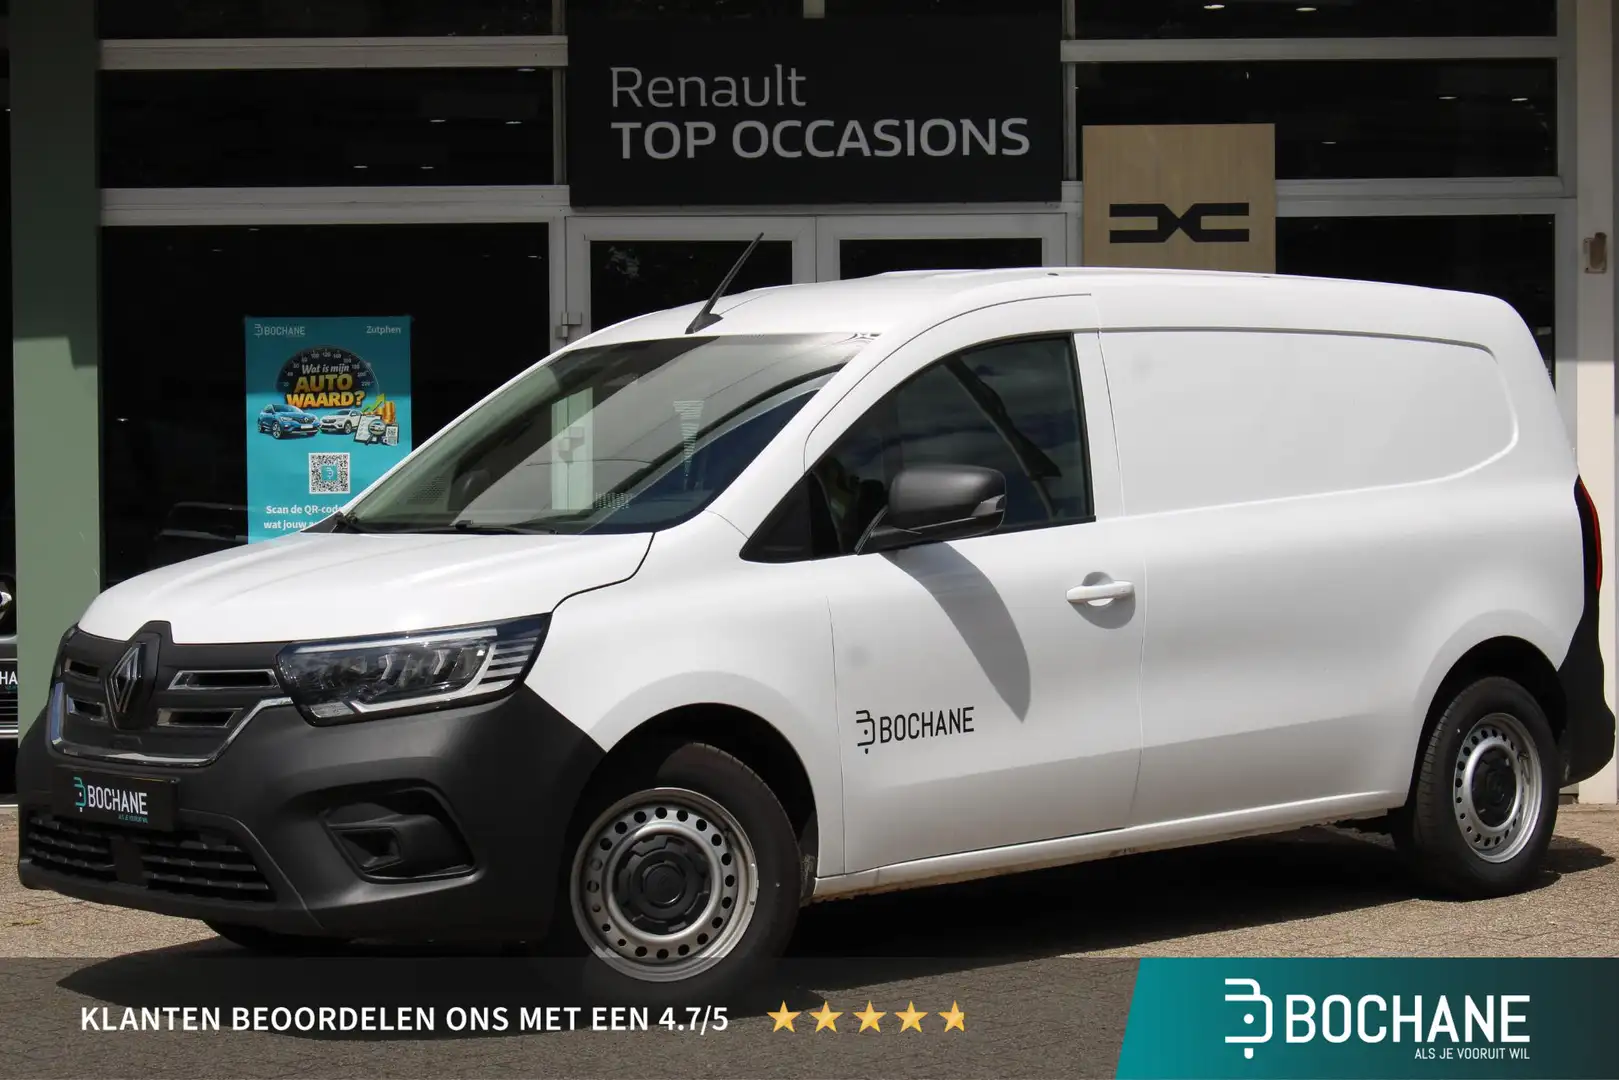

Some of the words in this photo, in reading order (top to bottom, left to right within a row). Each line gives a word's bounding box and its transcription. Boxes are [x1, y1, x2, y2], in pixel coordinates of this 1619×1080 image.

[610, 64, 806, 107] Renault
[611, 121, 716, 159] TOP
[732, 118, 1030, 158] OCCASIONS
[264, 325, 306, 336] BOCHANE
[366, 325, 401, 335] Zutphen
[301, 363, 320, 375] Wat
[322, 363, 330, 372] is
[330, 363, 350, 375] mijn
[293, 373, 353, 394] AUTO
[286, 390, 365, 408] WAARD?
[266, 505, 289, 514] Scan
[291, 504, 303, 514] de
[264, 520, 282, 529] wat
[282, 520, 307, 530] jouw
[880, 706, 974, 743] BOCHANE
[87, 785, 148, 815] BOCHANE
